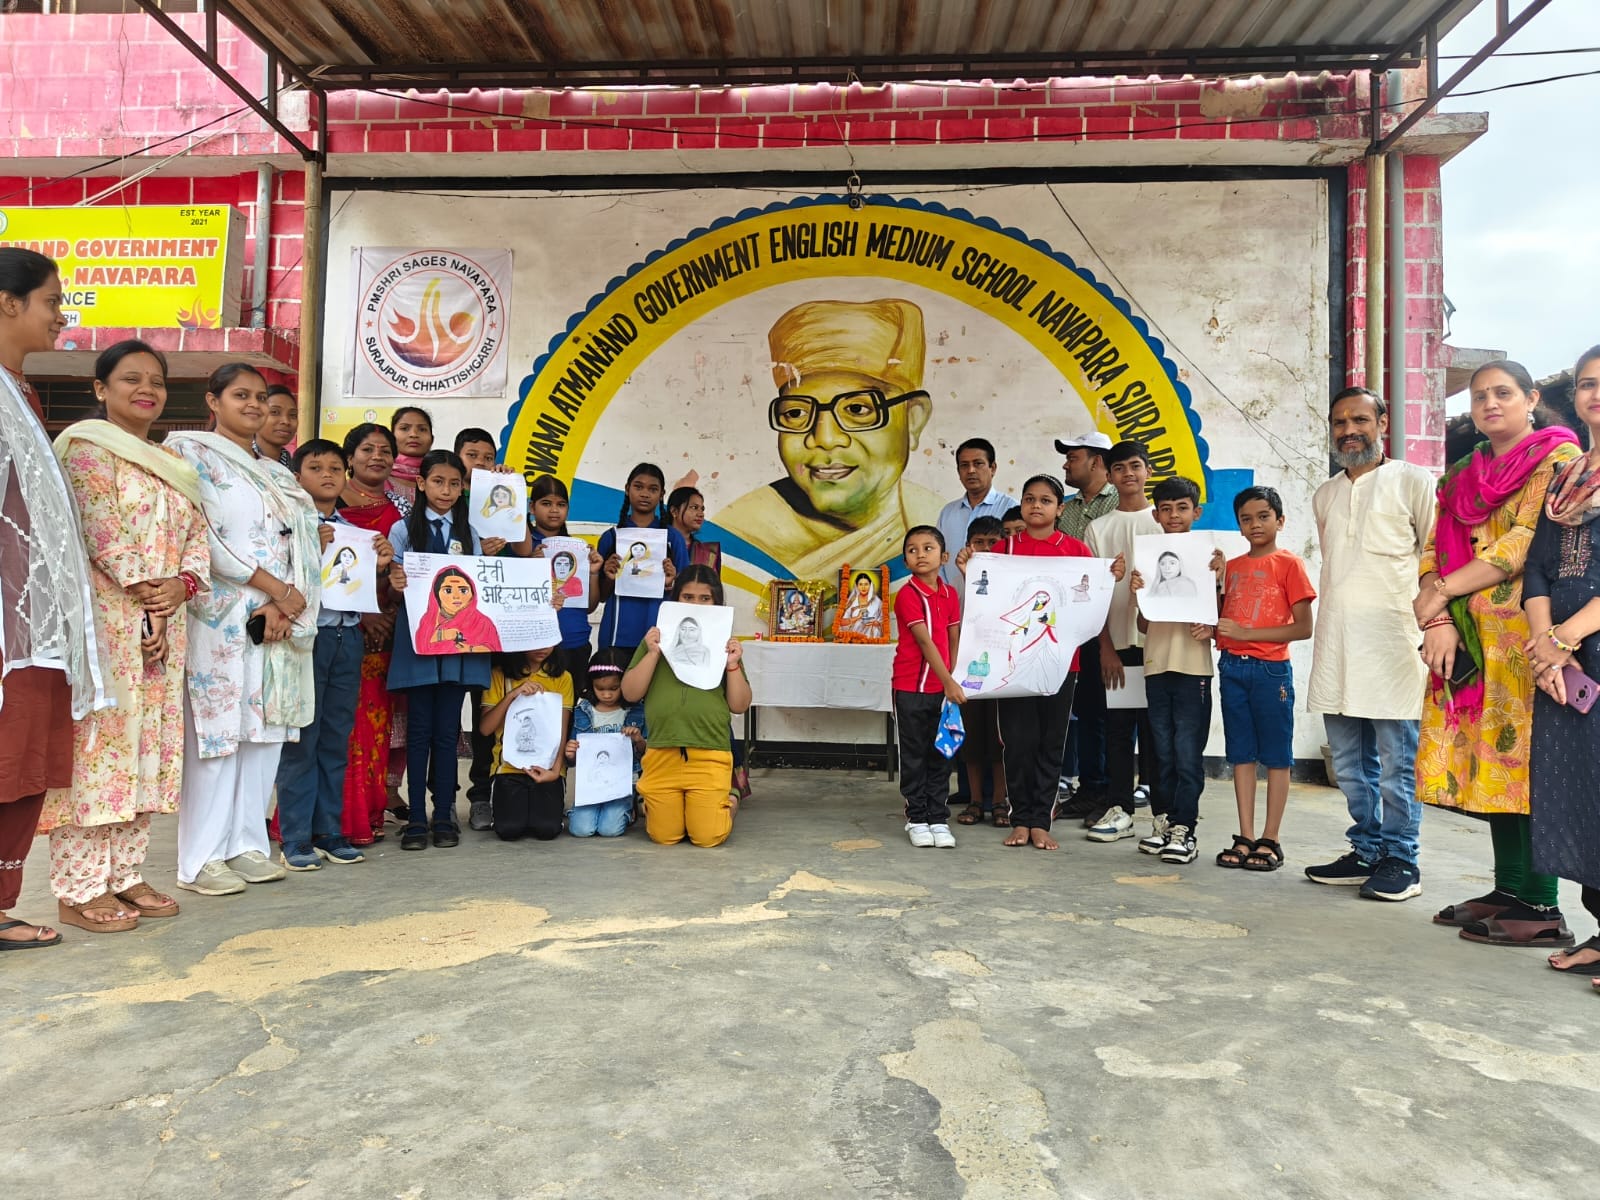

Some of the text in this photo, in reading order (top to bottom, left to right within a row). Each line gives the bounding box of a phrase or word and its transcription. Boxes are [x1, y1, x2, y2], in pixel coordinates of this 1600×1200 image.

[180, 209, 221, 217] EST. YEAR
[190, 218, 208, 226] 2021
[75, 239, 218, 258] GOVERNMENT
[75, 267, 196, 285] NAVAPARA
[367, 256, 497, 314] PMSHRI SAGES NAVAPARA
[547, 312, 639, 422] ATMANAND
[633, 232, 760, 325] GOVERNMENT
[769, 220, 859, 264] ENGLISH
[865, 222, 956, 271] MEDIUM
[952, 246, 1037, 312] SCHOOL
[1028, 290, 1131, 392] NAVAPARA
[365, 336, 496, 392] SURAJPUR, CHHATTISHGARH
[476, 558, 505, 584] देवी
